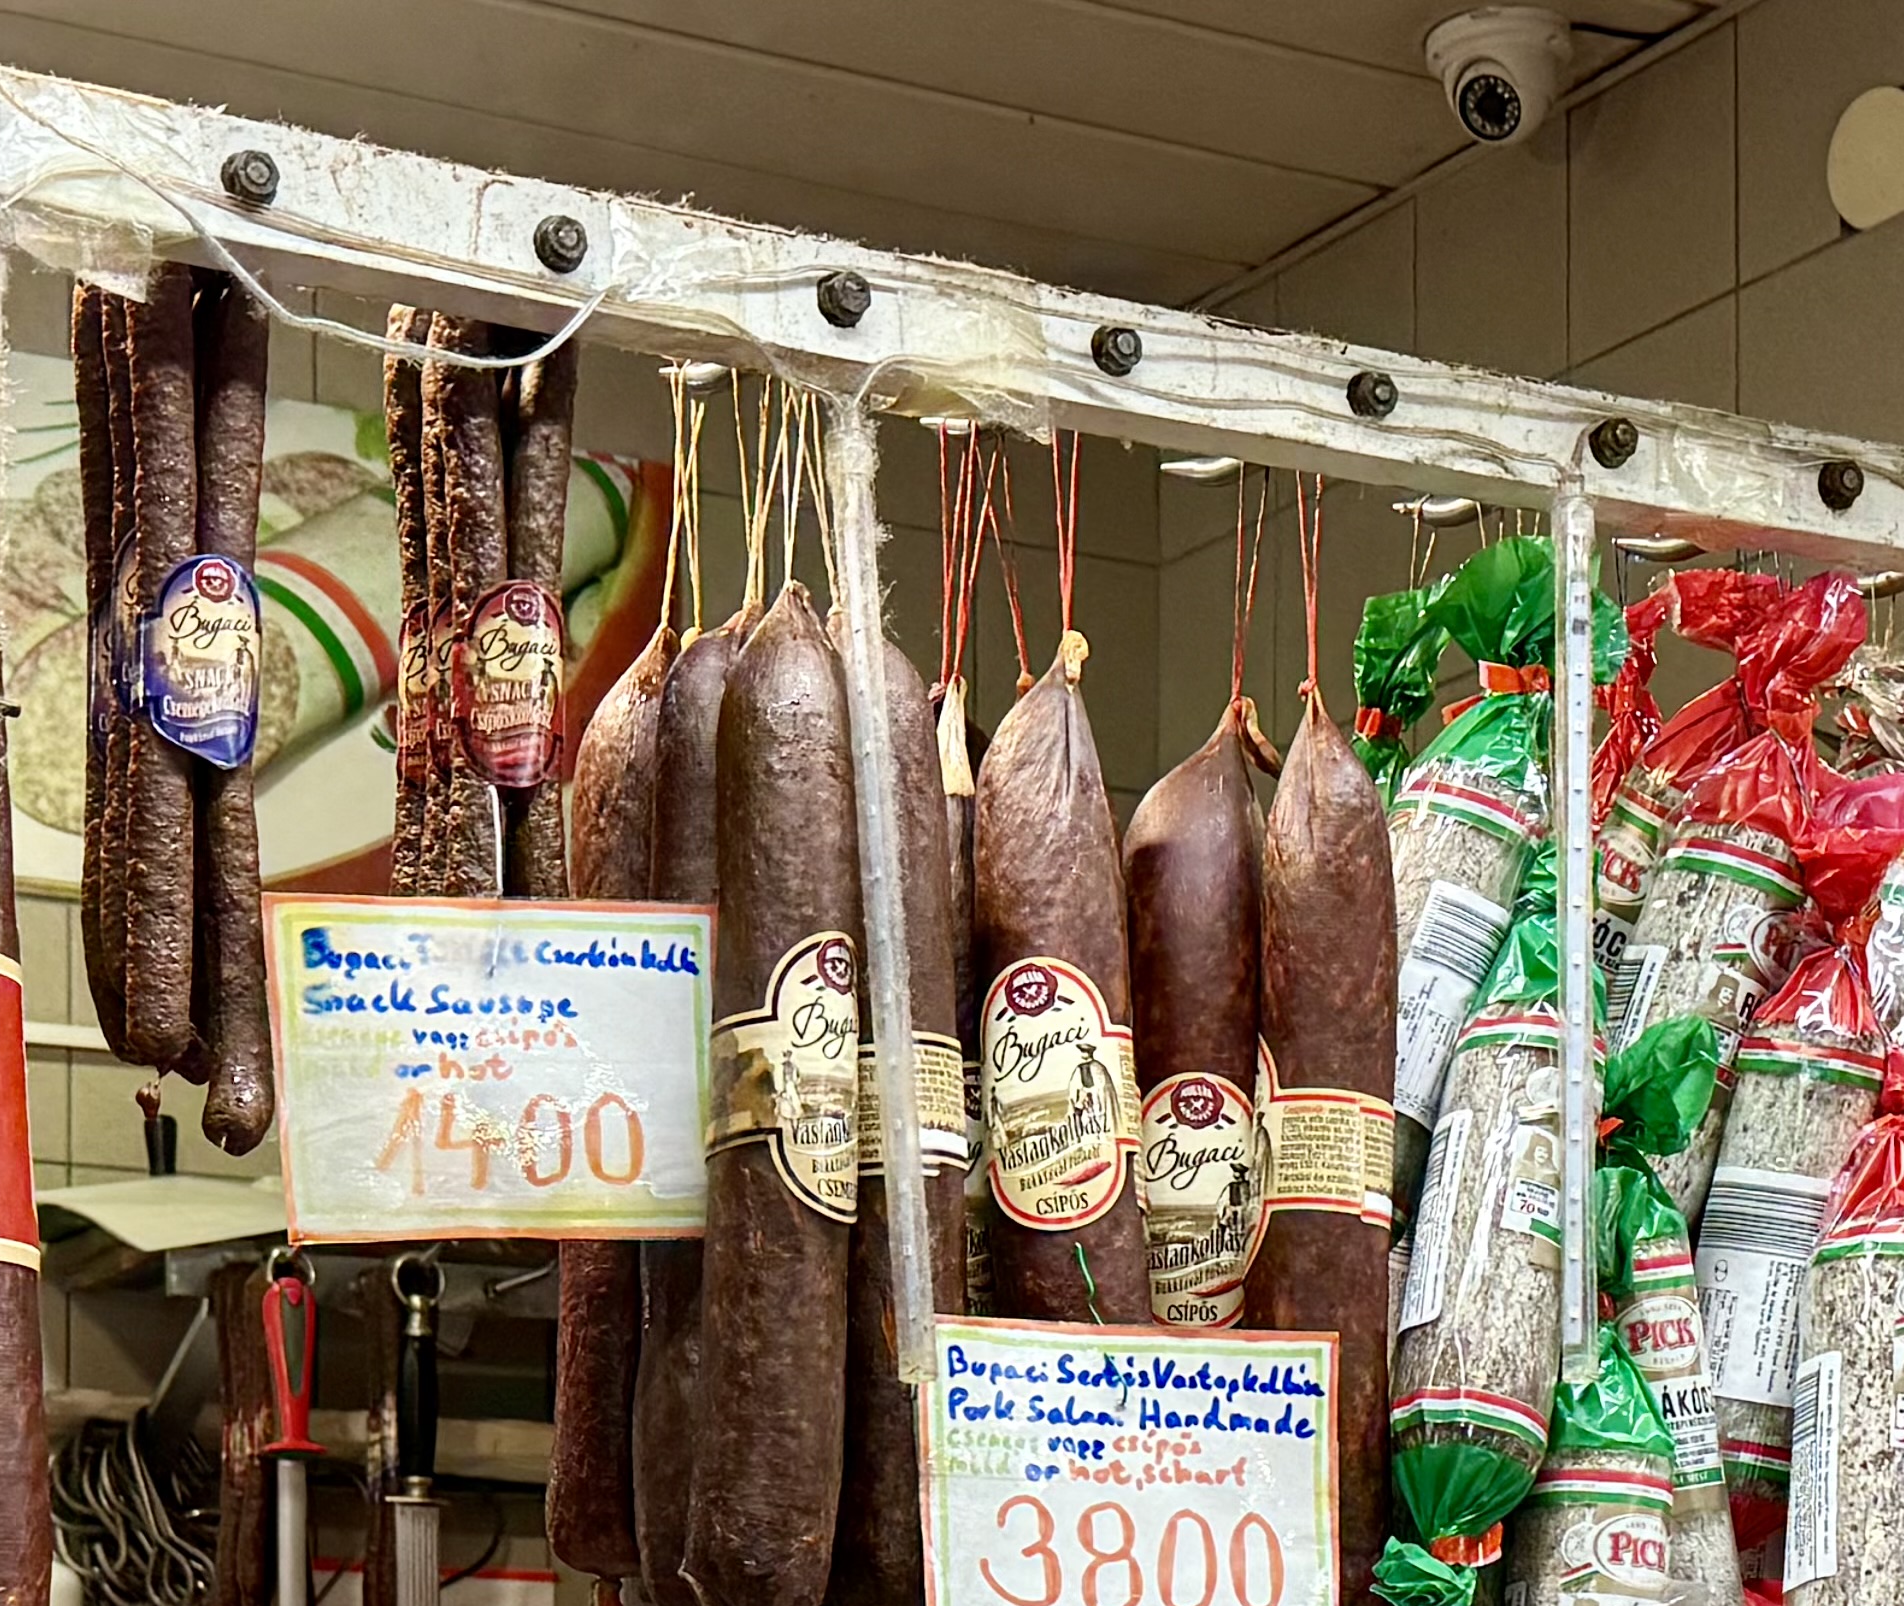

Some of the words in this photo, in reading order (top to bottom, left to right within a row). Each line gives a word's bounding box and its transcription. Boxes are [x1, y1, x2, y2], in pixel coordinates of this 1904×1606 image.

[169, 600, 252, 649] Bugaci
[478, 624, 557, 672] Bugaci
[302, 980, 417, 1018] Snack
[425, 984, 578, 1024] Sausage
[395, 1062, 432, 1079] or
[438, 1053, 514, 1081] hot
[992, 1016, 1091, 1083] Bugaci
[374, 1086, 645, 1197] 1400
[1147, 1133, 1245, 1191] Bugaci
[1036, 1191, 1089, 1216] CSÍPŐS
[1167, 1302, 1219, 1323] CSÍPŐS
[1625, 1316, 1697, 1356] PICK
[948, 1388, 1014, 1421] Pork
[1139, 1397, 1317, 1439] Handmade
[1024, 1463, 1060, 1481] or
